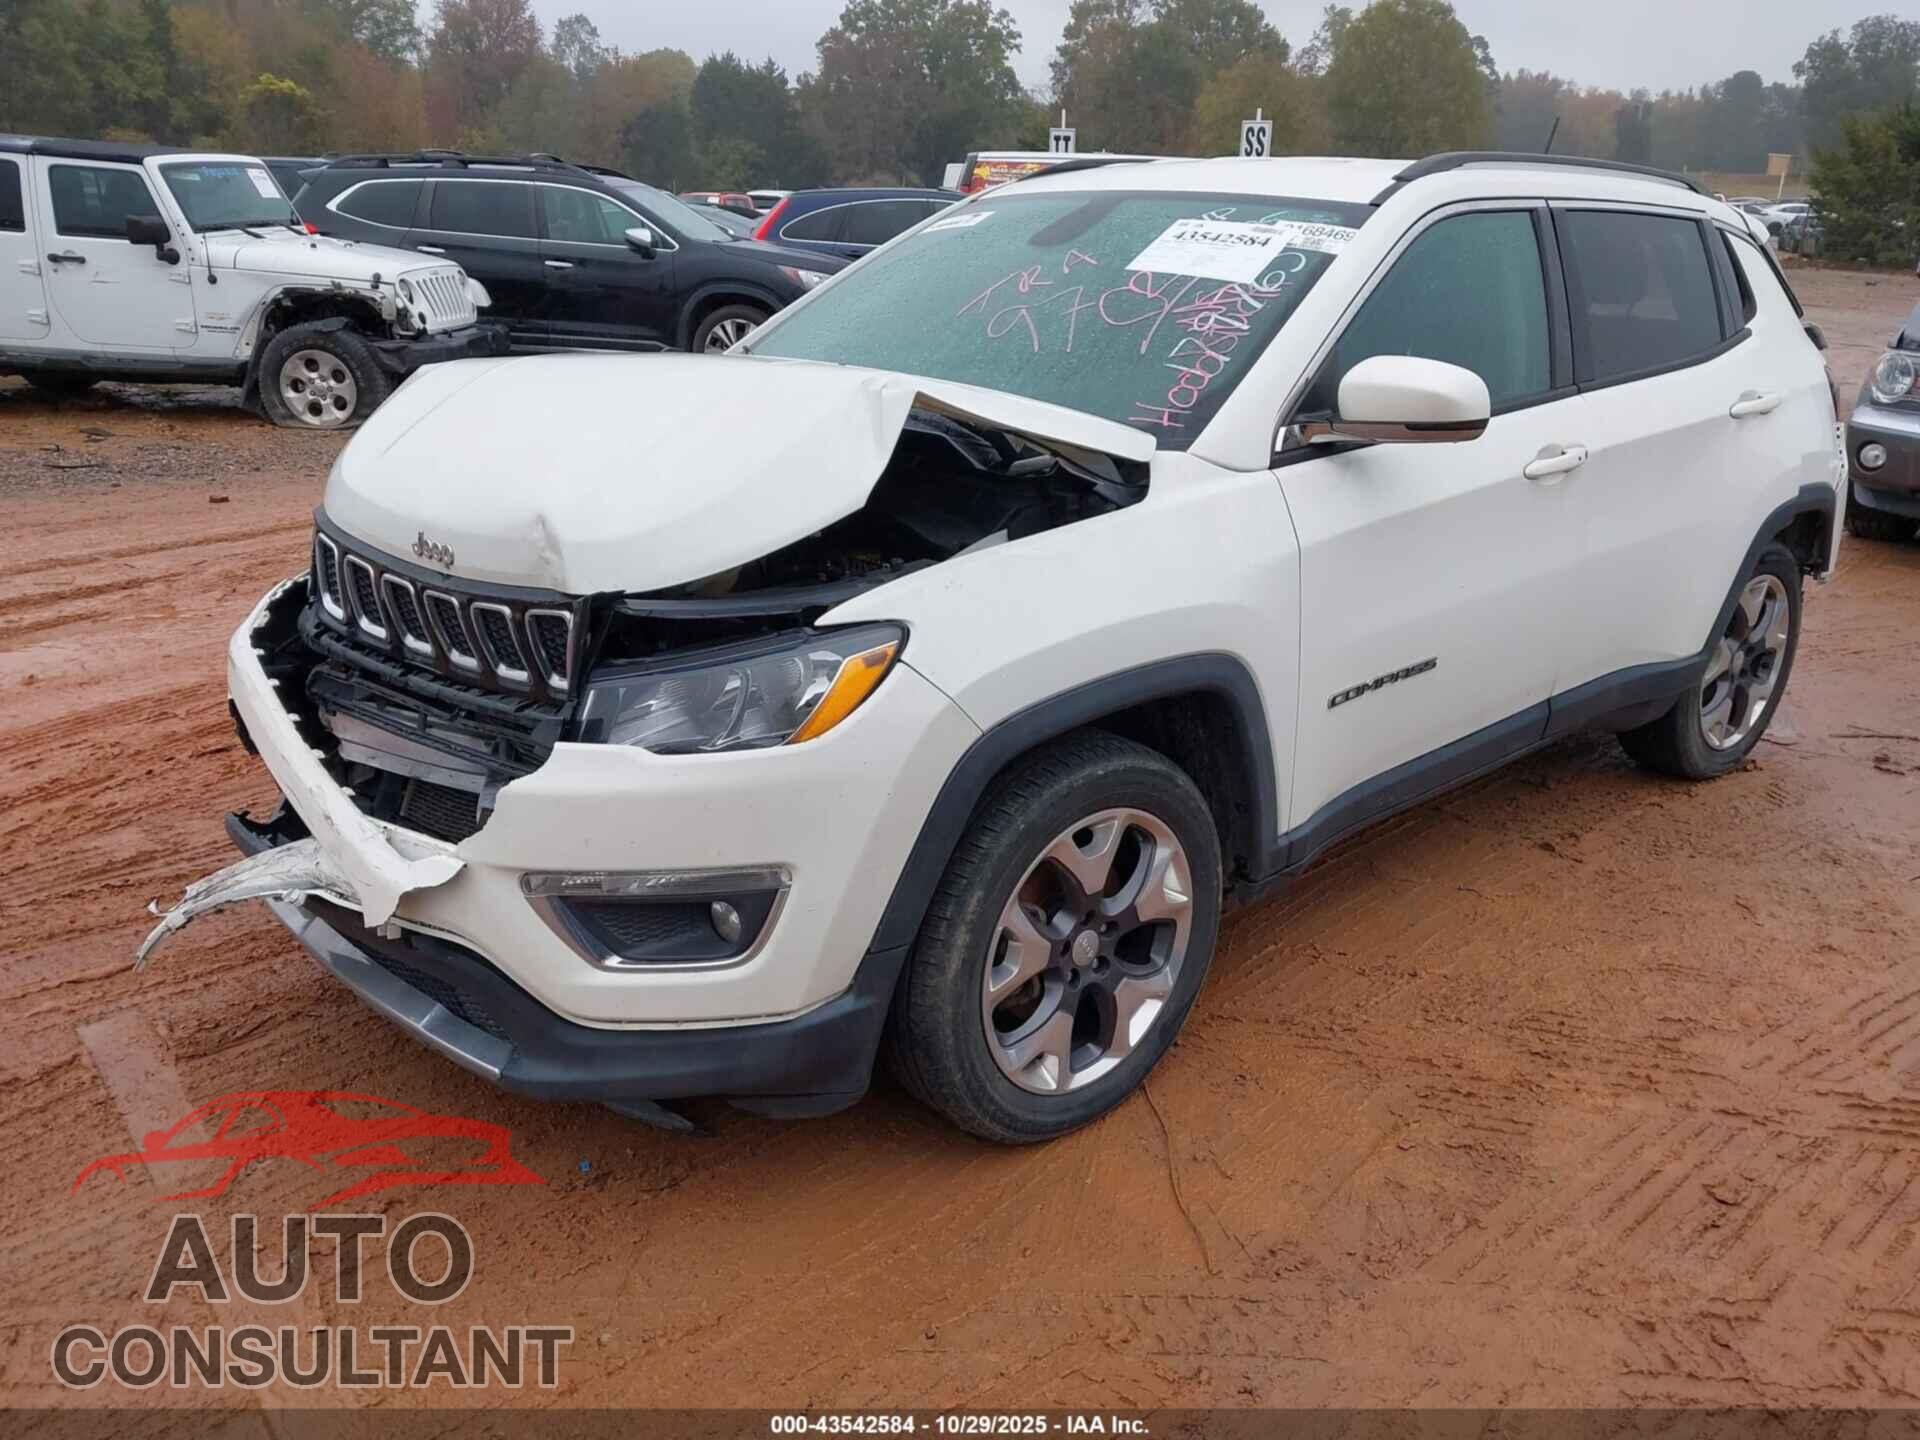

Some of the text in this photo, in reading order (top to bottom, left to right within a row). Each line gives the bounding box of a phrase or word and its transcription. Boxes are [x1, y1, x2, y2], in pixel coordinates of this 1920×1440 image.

[1053, 134, 1071, 153] TT
[1244, 126, 1266, 157] SS
[1172, 230, 1272, 247] 43542584
[411, 530, 455, 570] Jeep
[1327, 656, 1438, 710] COMPASS
